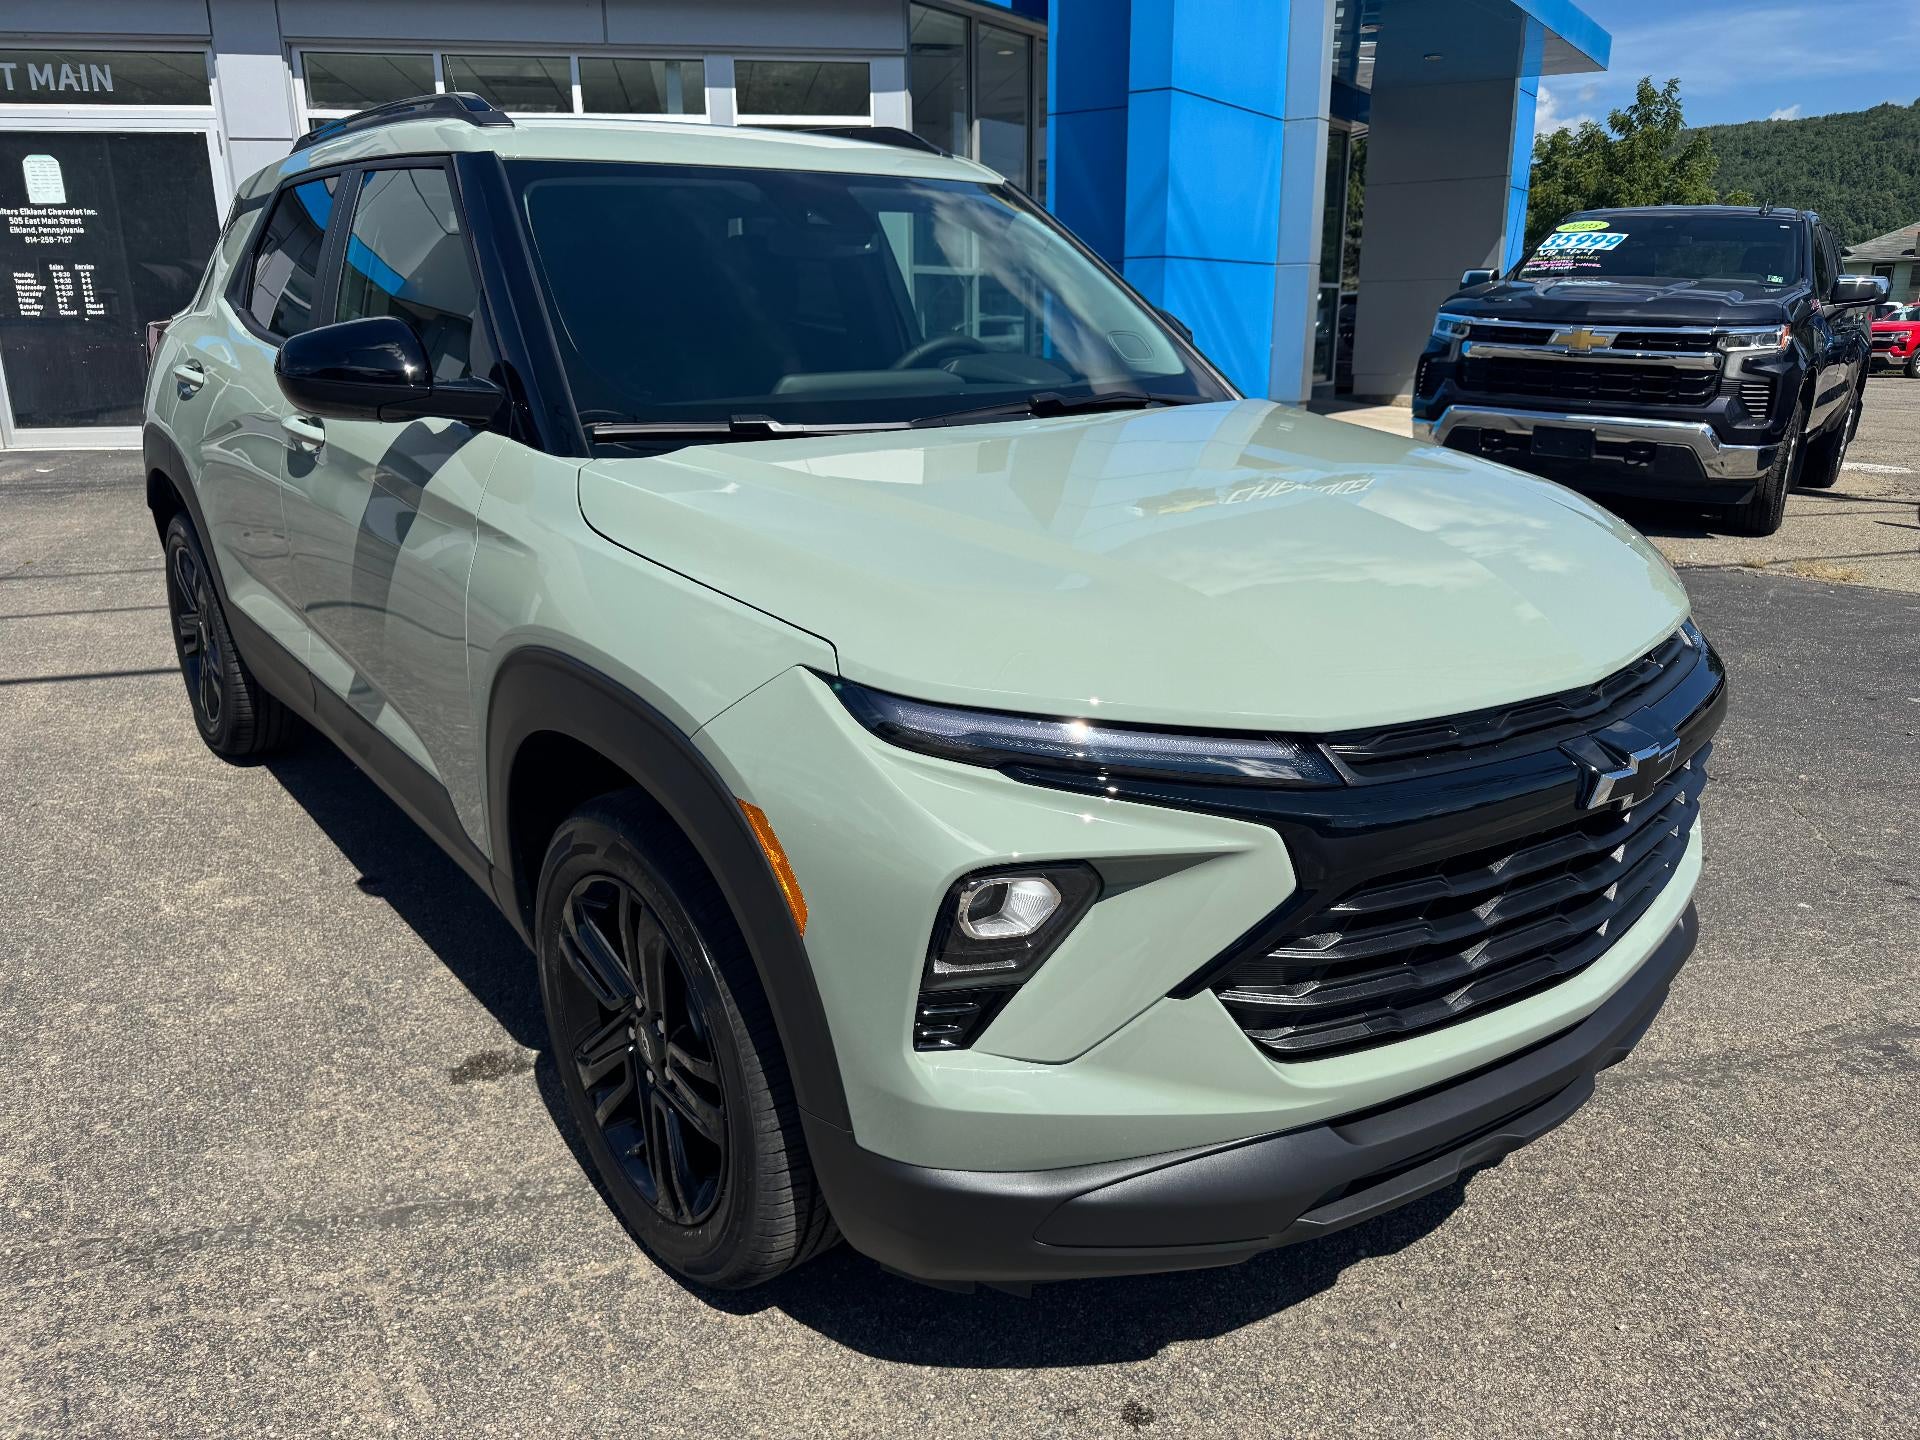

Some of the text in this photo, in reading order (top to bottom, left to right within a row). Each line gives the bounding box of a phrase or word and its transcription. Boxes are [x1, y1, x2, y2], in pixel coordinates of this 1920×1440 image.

[27, 63, 113, 91] MAIN
[10, 226, 84, 235] Elkland, Pennsylvania
[1541, 233, 1624, 248] 35999
